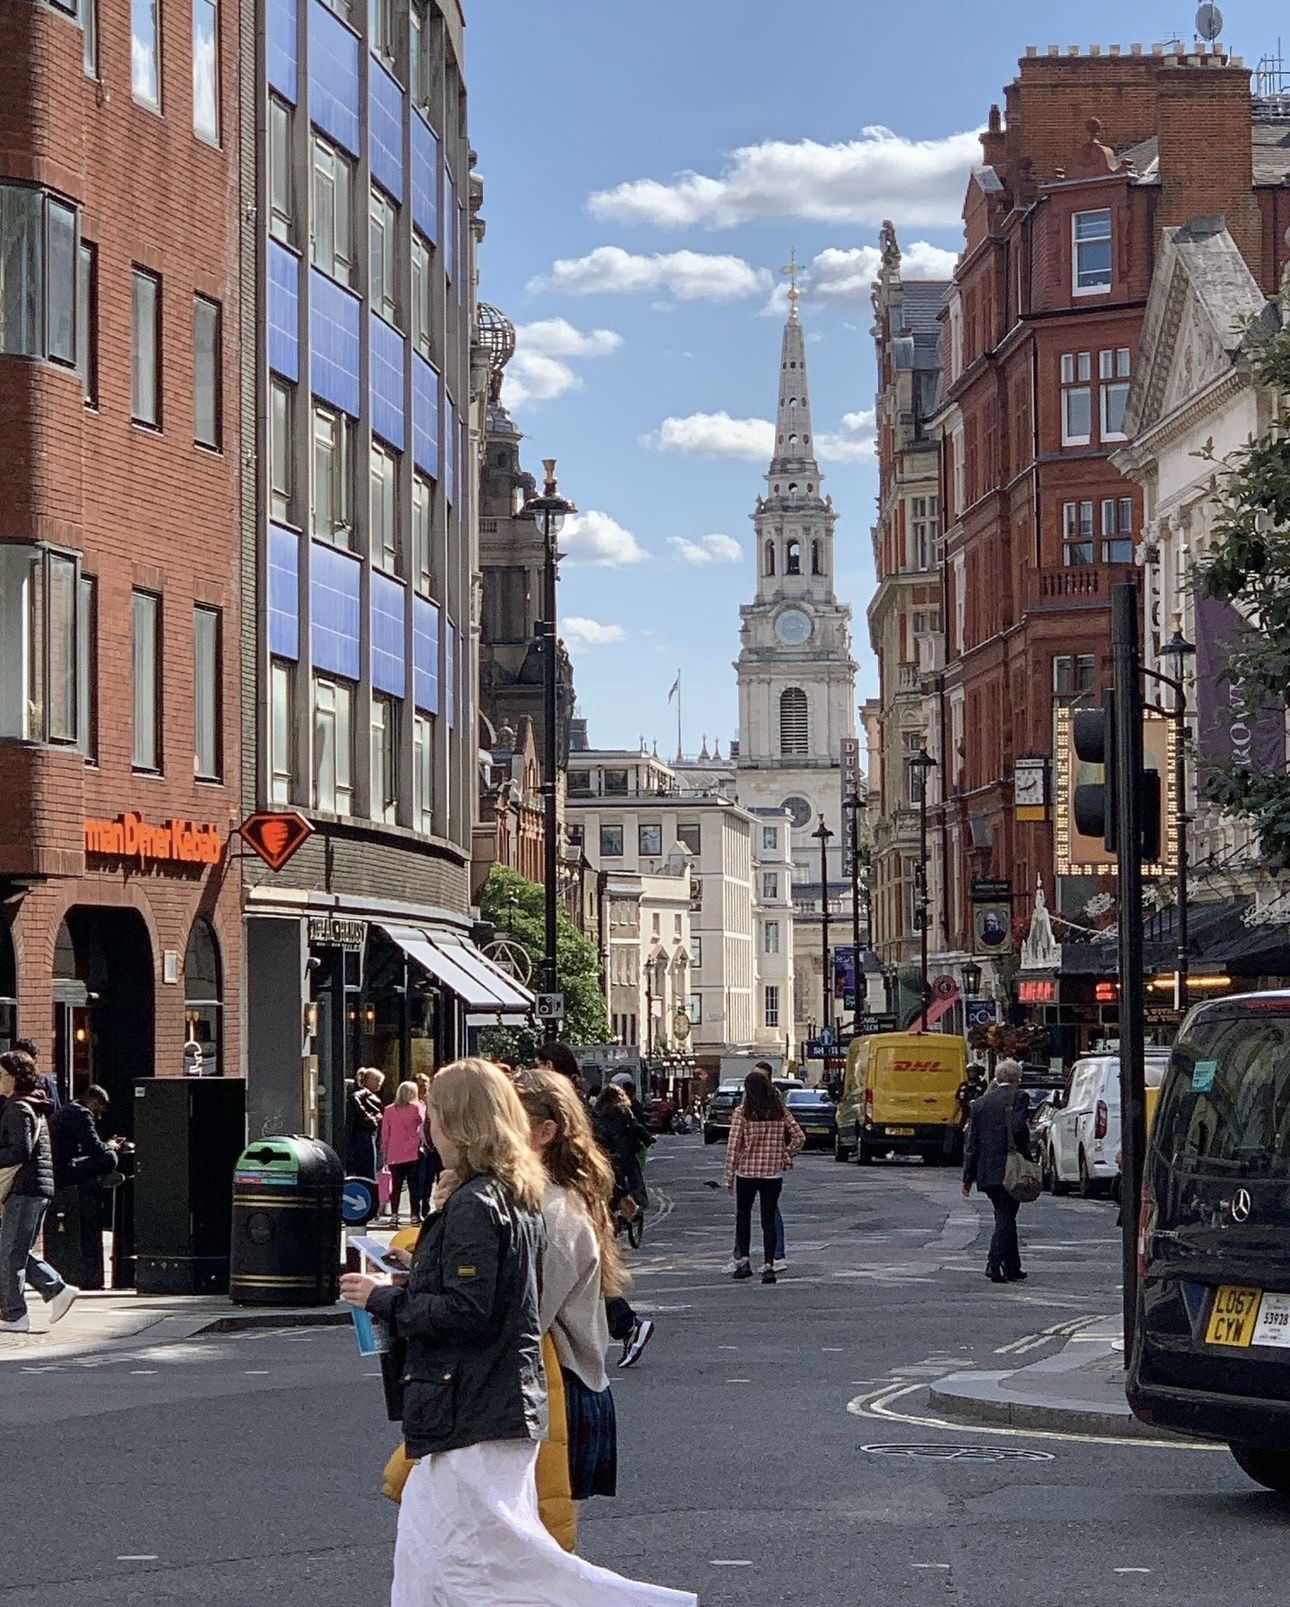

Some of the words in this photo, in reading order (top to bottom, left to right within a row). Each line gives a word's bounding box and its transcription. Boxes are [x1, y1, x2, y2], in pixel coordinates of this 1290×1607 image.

[172, 818, 219, 864] Kebab
[893, 1061, 942, 1073] DHL
[1214, 1317, 1246, 1342] CYN
